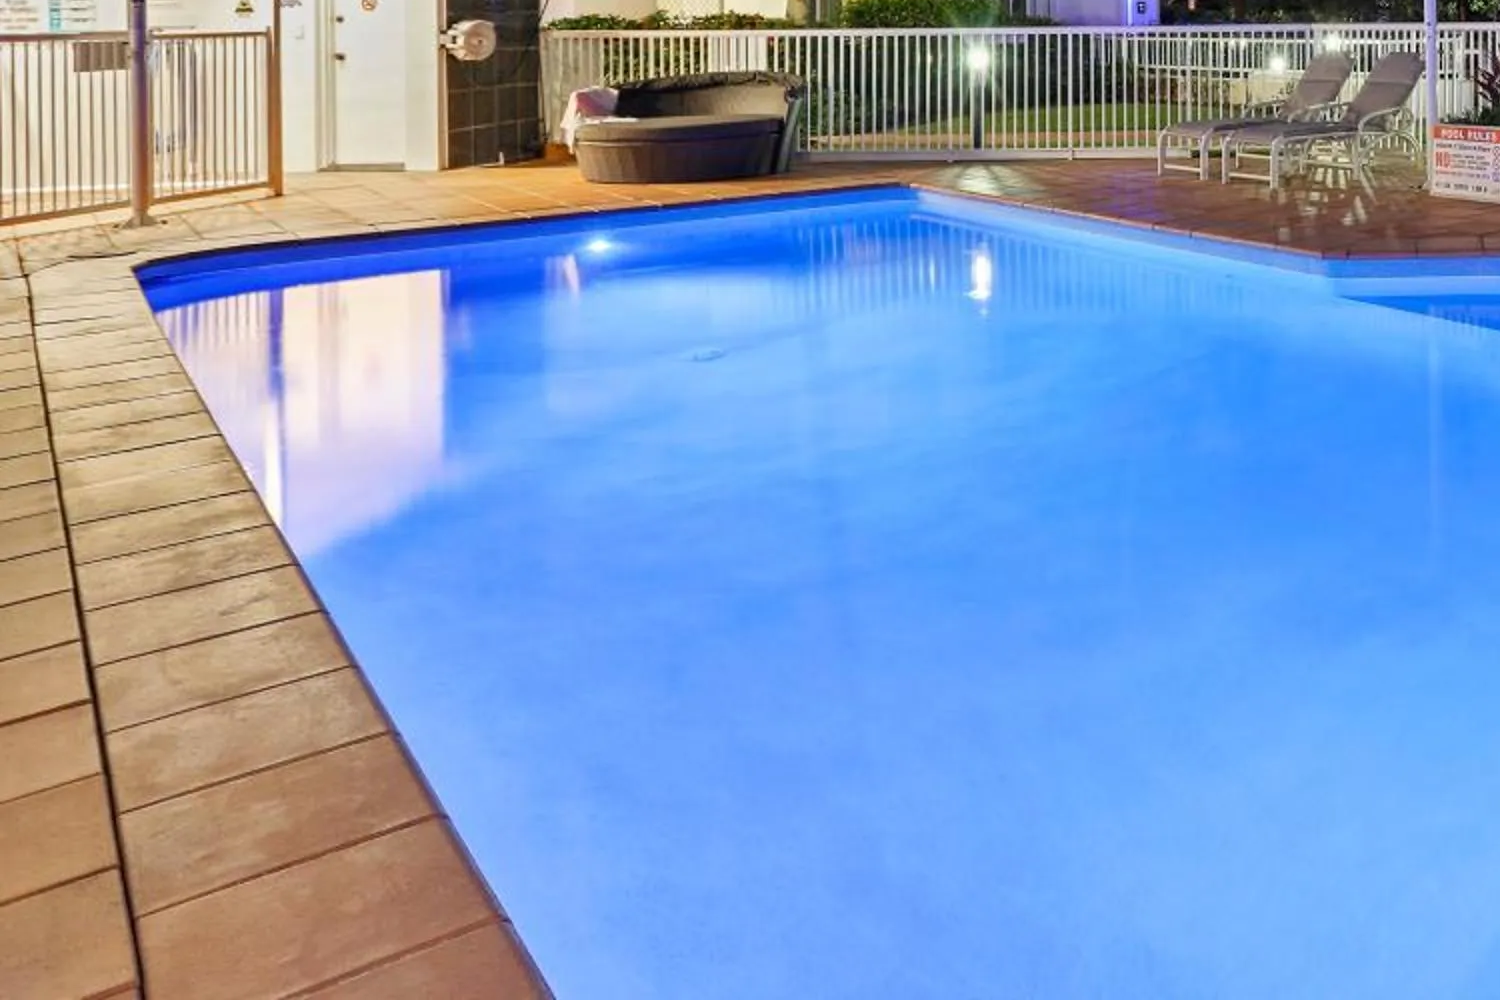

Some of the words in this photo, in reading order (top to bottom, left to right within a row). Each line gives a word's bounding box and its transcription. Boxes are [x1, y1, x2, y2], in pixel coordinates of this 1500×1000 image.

[1441, 128, 1465, 139] POOL
[1467, 130, 1497, 142] RULES
[1435, 152, 1451, 167] NO
